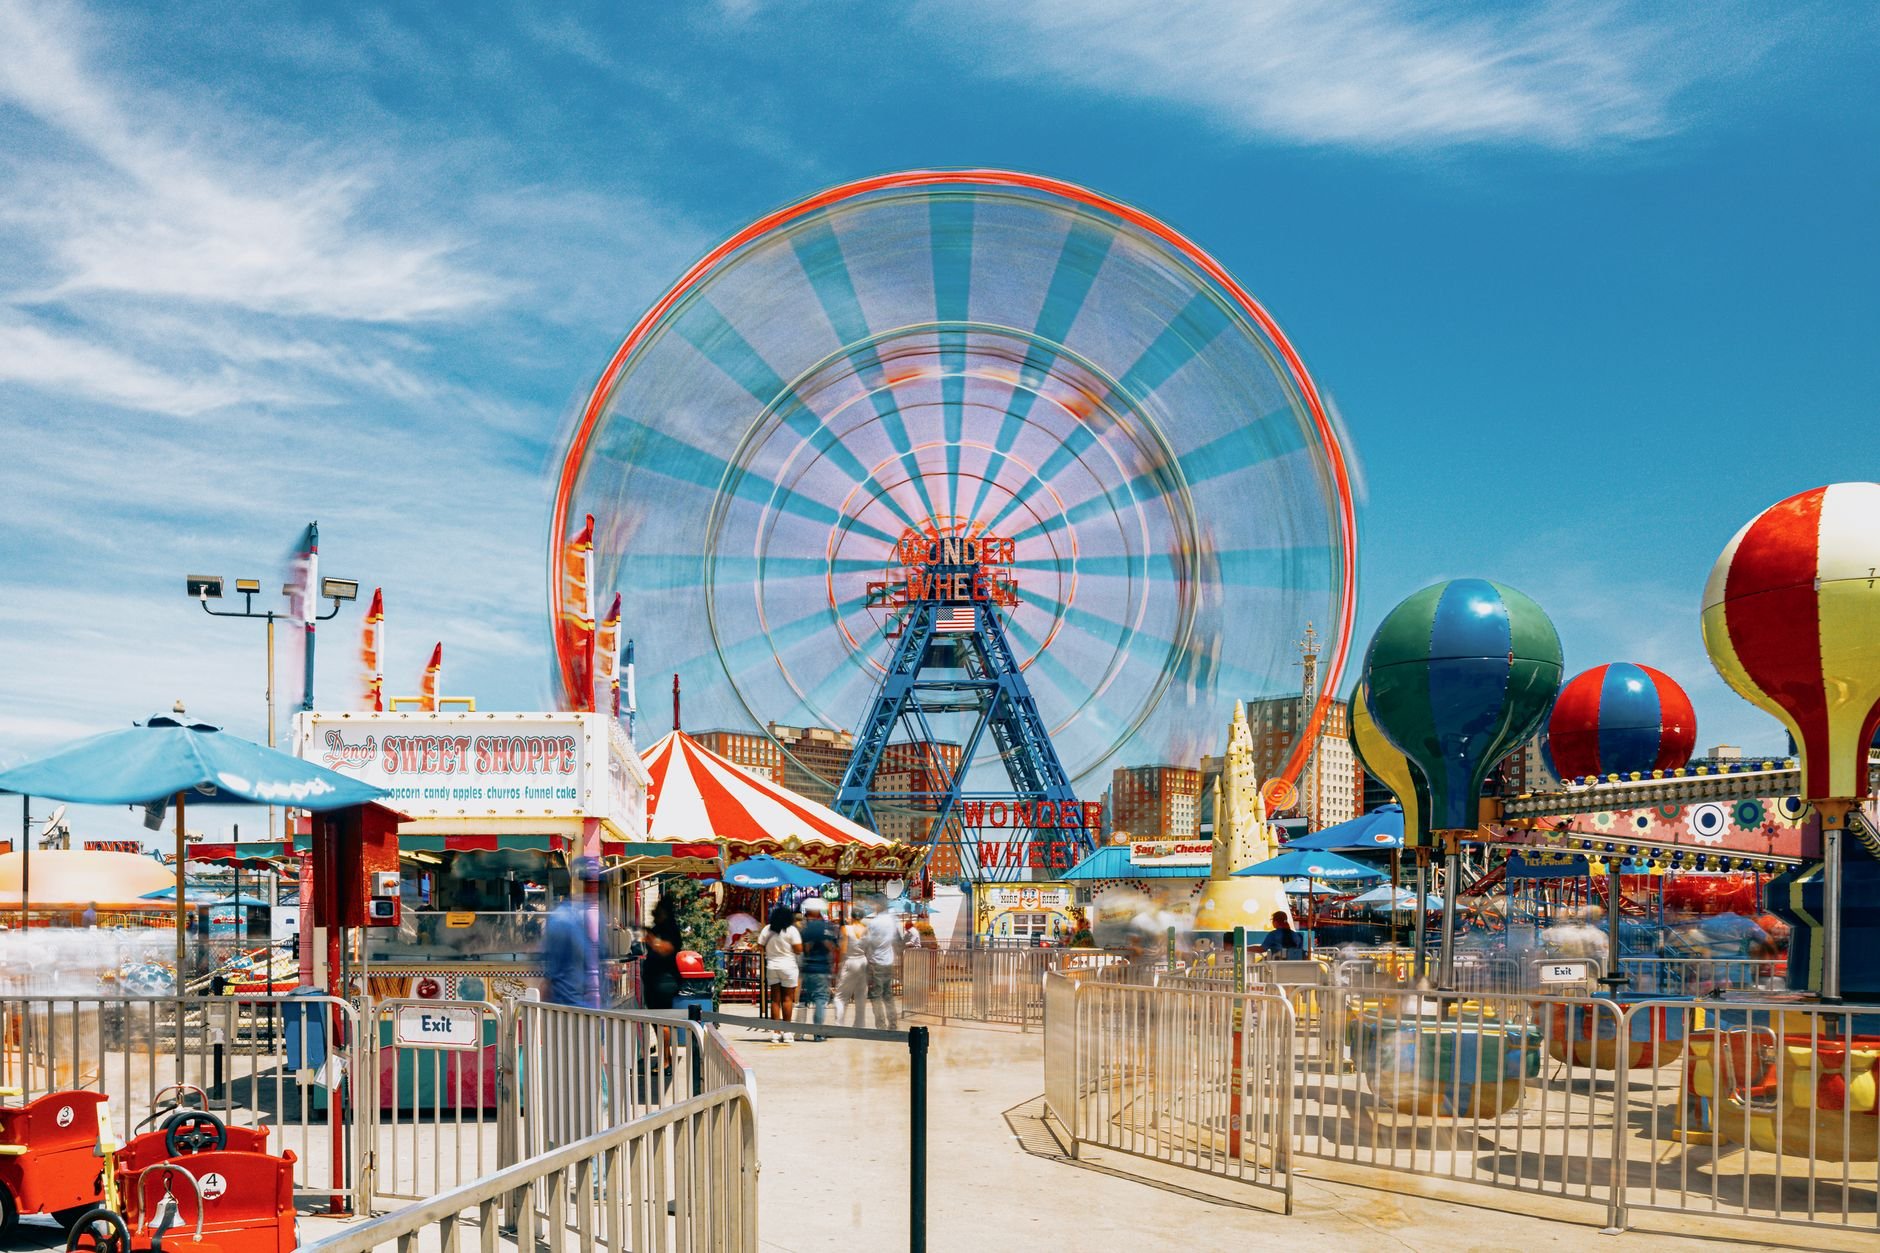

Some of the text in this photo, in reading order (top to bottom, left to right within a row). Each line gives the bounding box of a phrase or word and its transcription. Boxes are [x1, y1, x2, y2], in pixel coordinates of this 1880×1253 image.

[898, 538, 1016, 566] WONDER
[1867, 567, 1876, 577] 7
[907, 573, 1007, 601] WHEEL
[1867, 579, 1875, 589] 7
[323, 729, 577, 775] Deno's SWEET SHOPPE
[385, 786, 577, 801] opcorn candy apples churros funnel cake
[963, 801, 1102, 829] WONDER
[84, 841, 139, 854] WONDER
[1829, 837, 1836, 846] 7
[1134, 844, 1155, 856] Say
[1554, 967, 1572, 976] Exit
[421, 1015, 452, 1033] Exit
[62, 1106, 70, 1118] 3
[206, 1173, 218, 1187] 4
